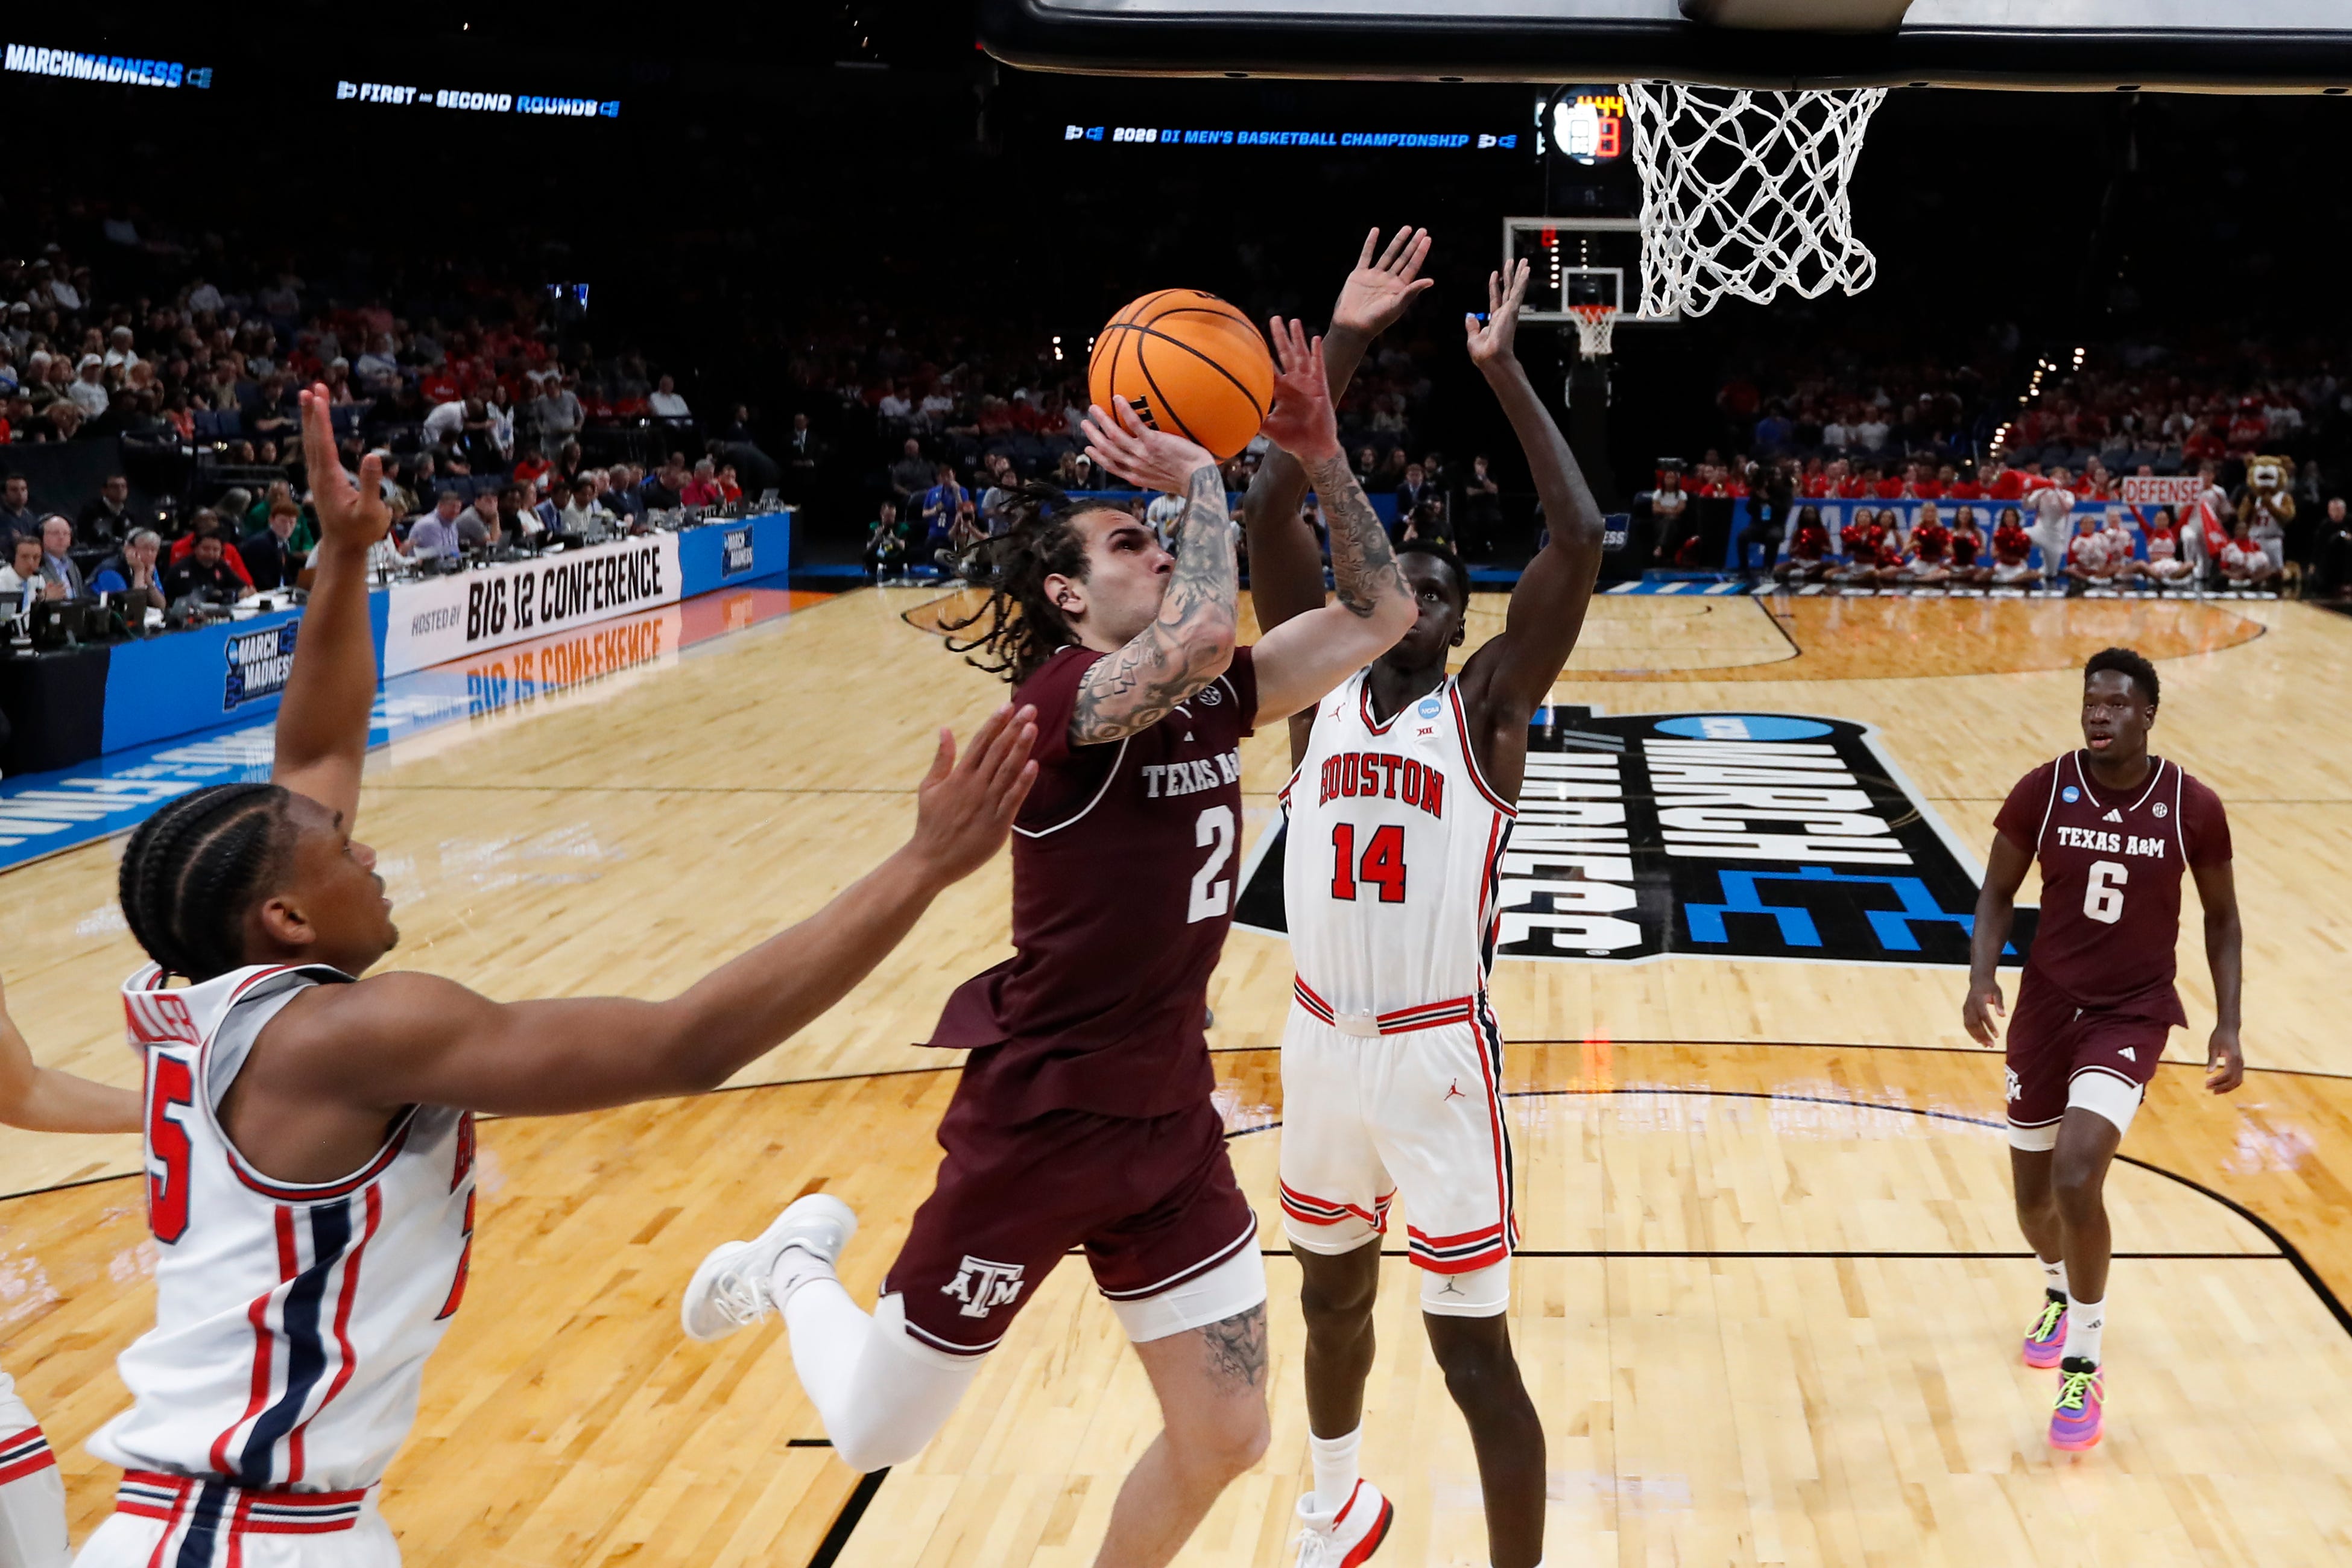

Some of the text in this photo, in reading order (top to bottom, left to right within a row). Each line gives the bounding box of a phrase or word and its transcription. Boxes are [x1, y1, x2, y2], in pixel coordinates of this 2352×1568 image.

[360, 83, 417, 105] FIRST
[436, 89, 512, 112] SECOND
[516, 95, 598, 117] ROUNDS
[1113, 127, 1157, 143] 2026
[1184, 130, 1234, 145] MEN'S
[1237, 131, 1337, 146] BASKETBALL
[1341, 133, 1470, 147] CHAMPIONSHIP
[2126, 480, 2199, 502] DEFENSE
[412, 608, 448, 637] HOSTED
[467, 577, 507, 643] BIG
[514, 571, 535, 630] 12
[540, 545, 663, 623] CONFERENCE
[238, 630, 279, 666] MARCH
[1142, 759, 1219, 797] TEXAS
[1320, 752, 1444, 820] HOUSTON
[1642, 738, 1914, 865] MARCH
[1187, 805, 1236, 923] 2
[1331, 823, 1406, 903] 14
[2057, 826, 2165, 858] TEXAS A&M
[2083, 859, 2128, 924] 6
[145, 1045, 194, 1245] 5
